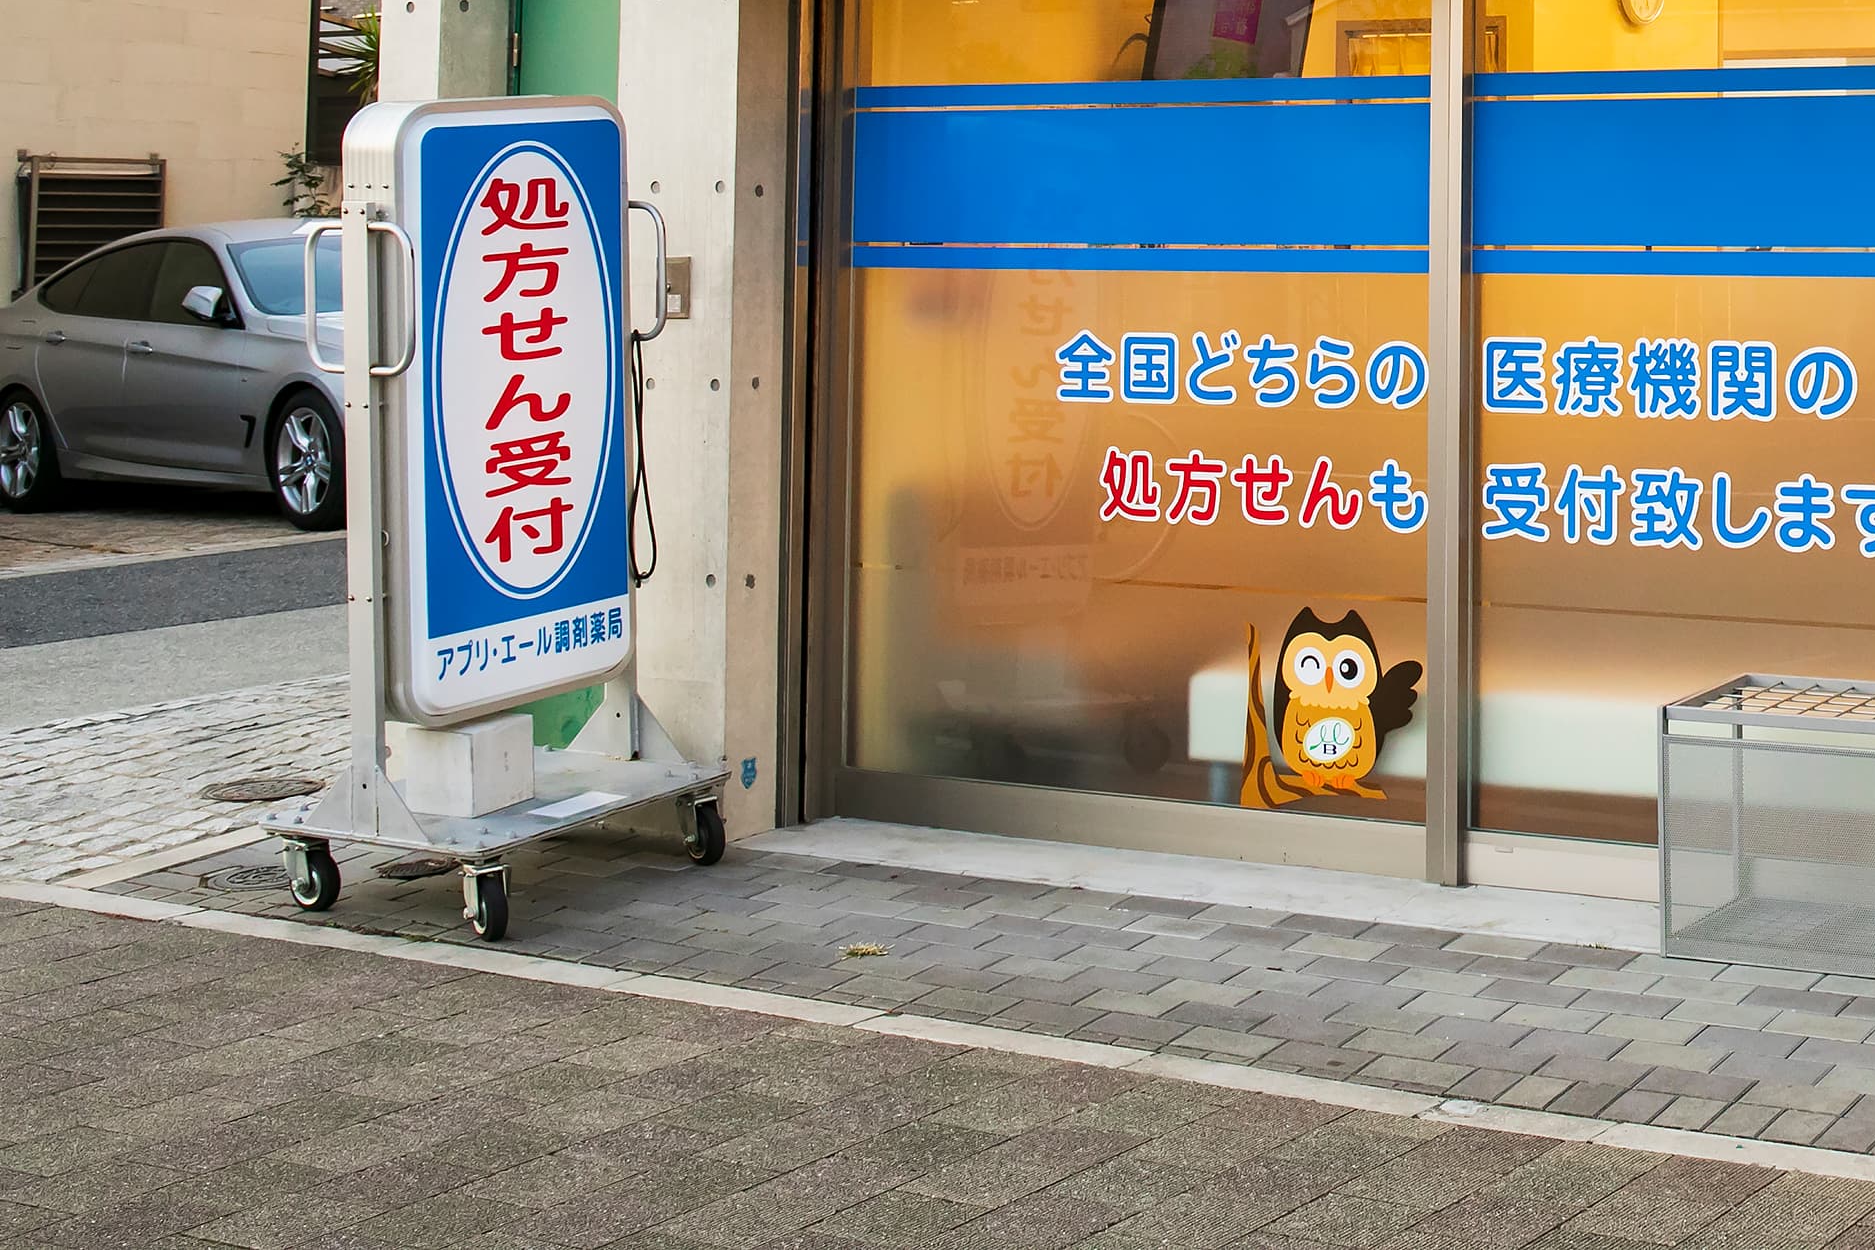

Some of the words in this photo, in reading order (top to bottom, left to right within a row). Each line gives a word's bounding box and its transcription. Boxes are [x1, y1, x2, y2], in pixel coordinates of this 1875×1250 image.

[479, 177, 575, 564] 処方せん受付
[1056, 330, 1430, 410] 全国どちらの
[1483, 335, 1858, 422] 医療機関の
[1099, 445, 1430, 534] 処方せんも
[436, 606, 623, 681] アプリ・エール調剤薬局
